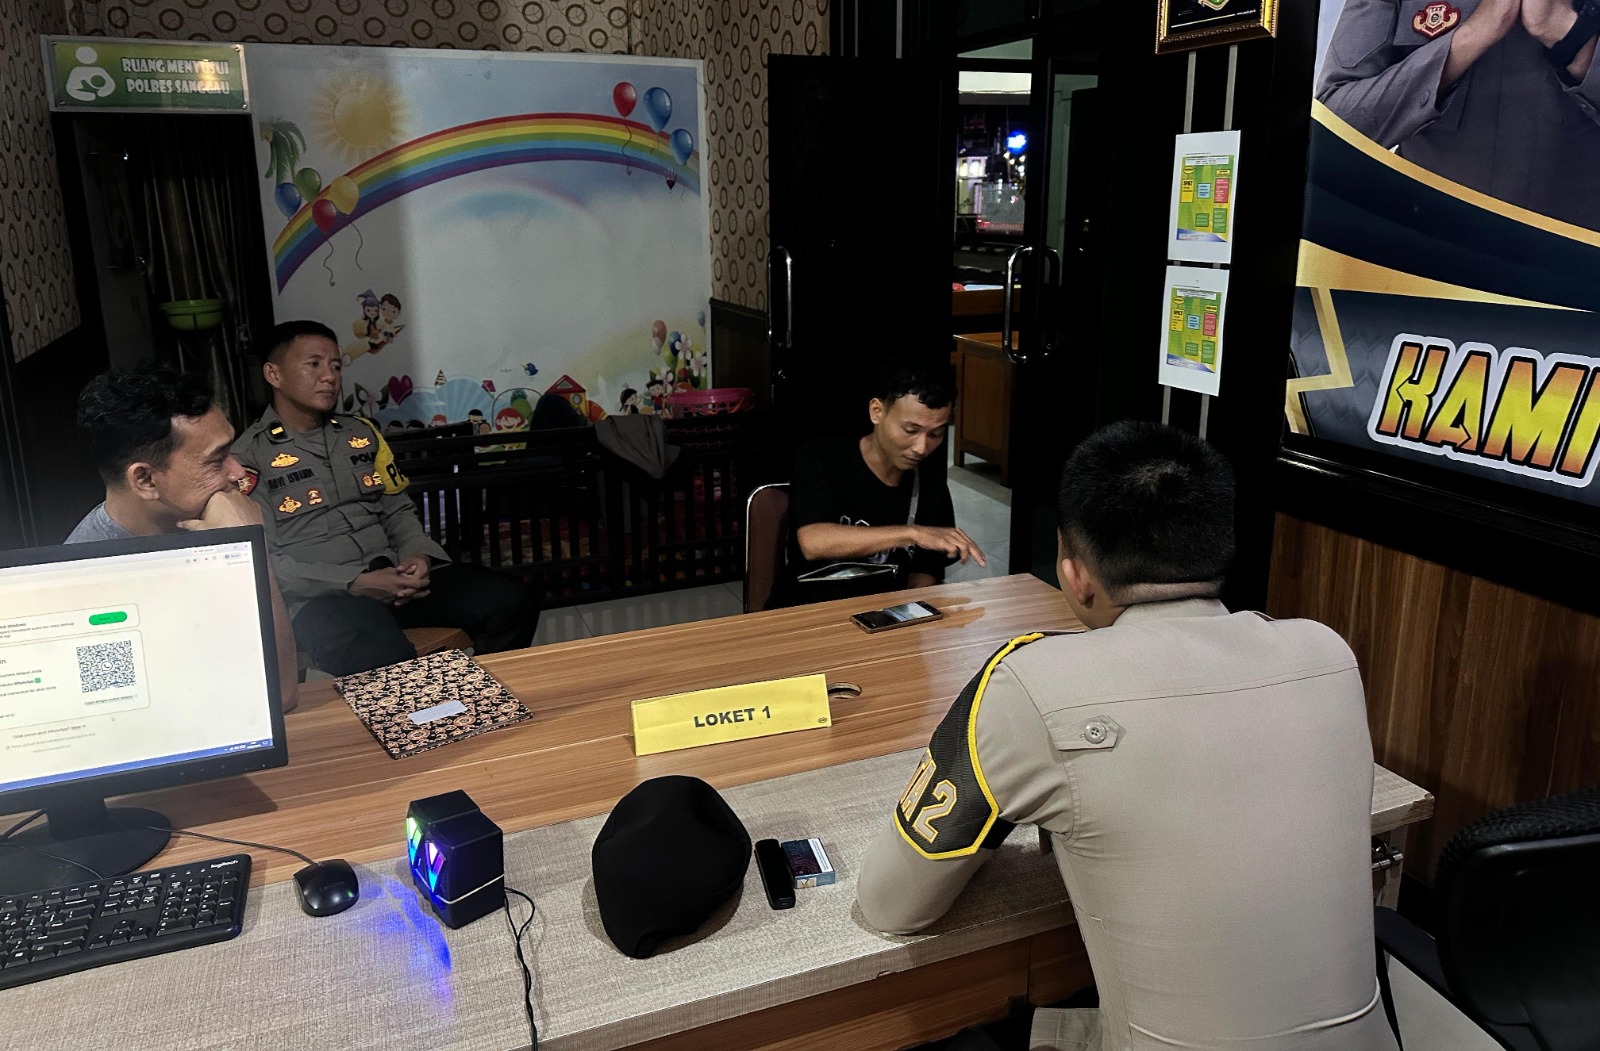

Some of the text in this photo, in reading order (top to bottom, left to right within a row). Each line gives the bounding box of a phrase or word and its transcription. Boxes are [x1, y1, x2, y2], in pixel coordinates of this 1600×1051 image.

[121, 57, 230, 75] RUANG MENYUSUI
[126, 78, 231, 95] POLRES SANGGAU
[1375, 339, 1600, 480] KAMI
[693, 705, 771, 728] LOKET 1
[911, 779, 957, 844] 2
